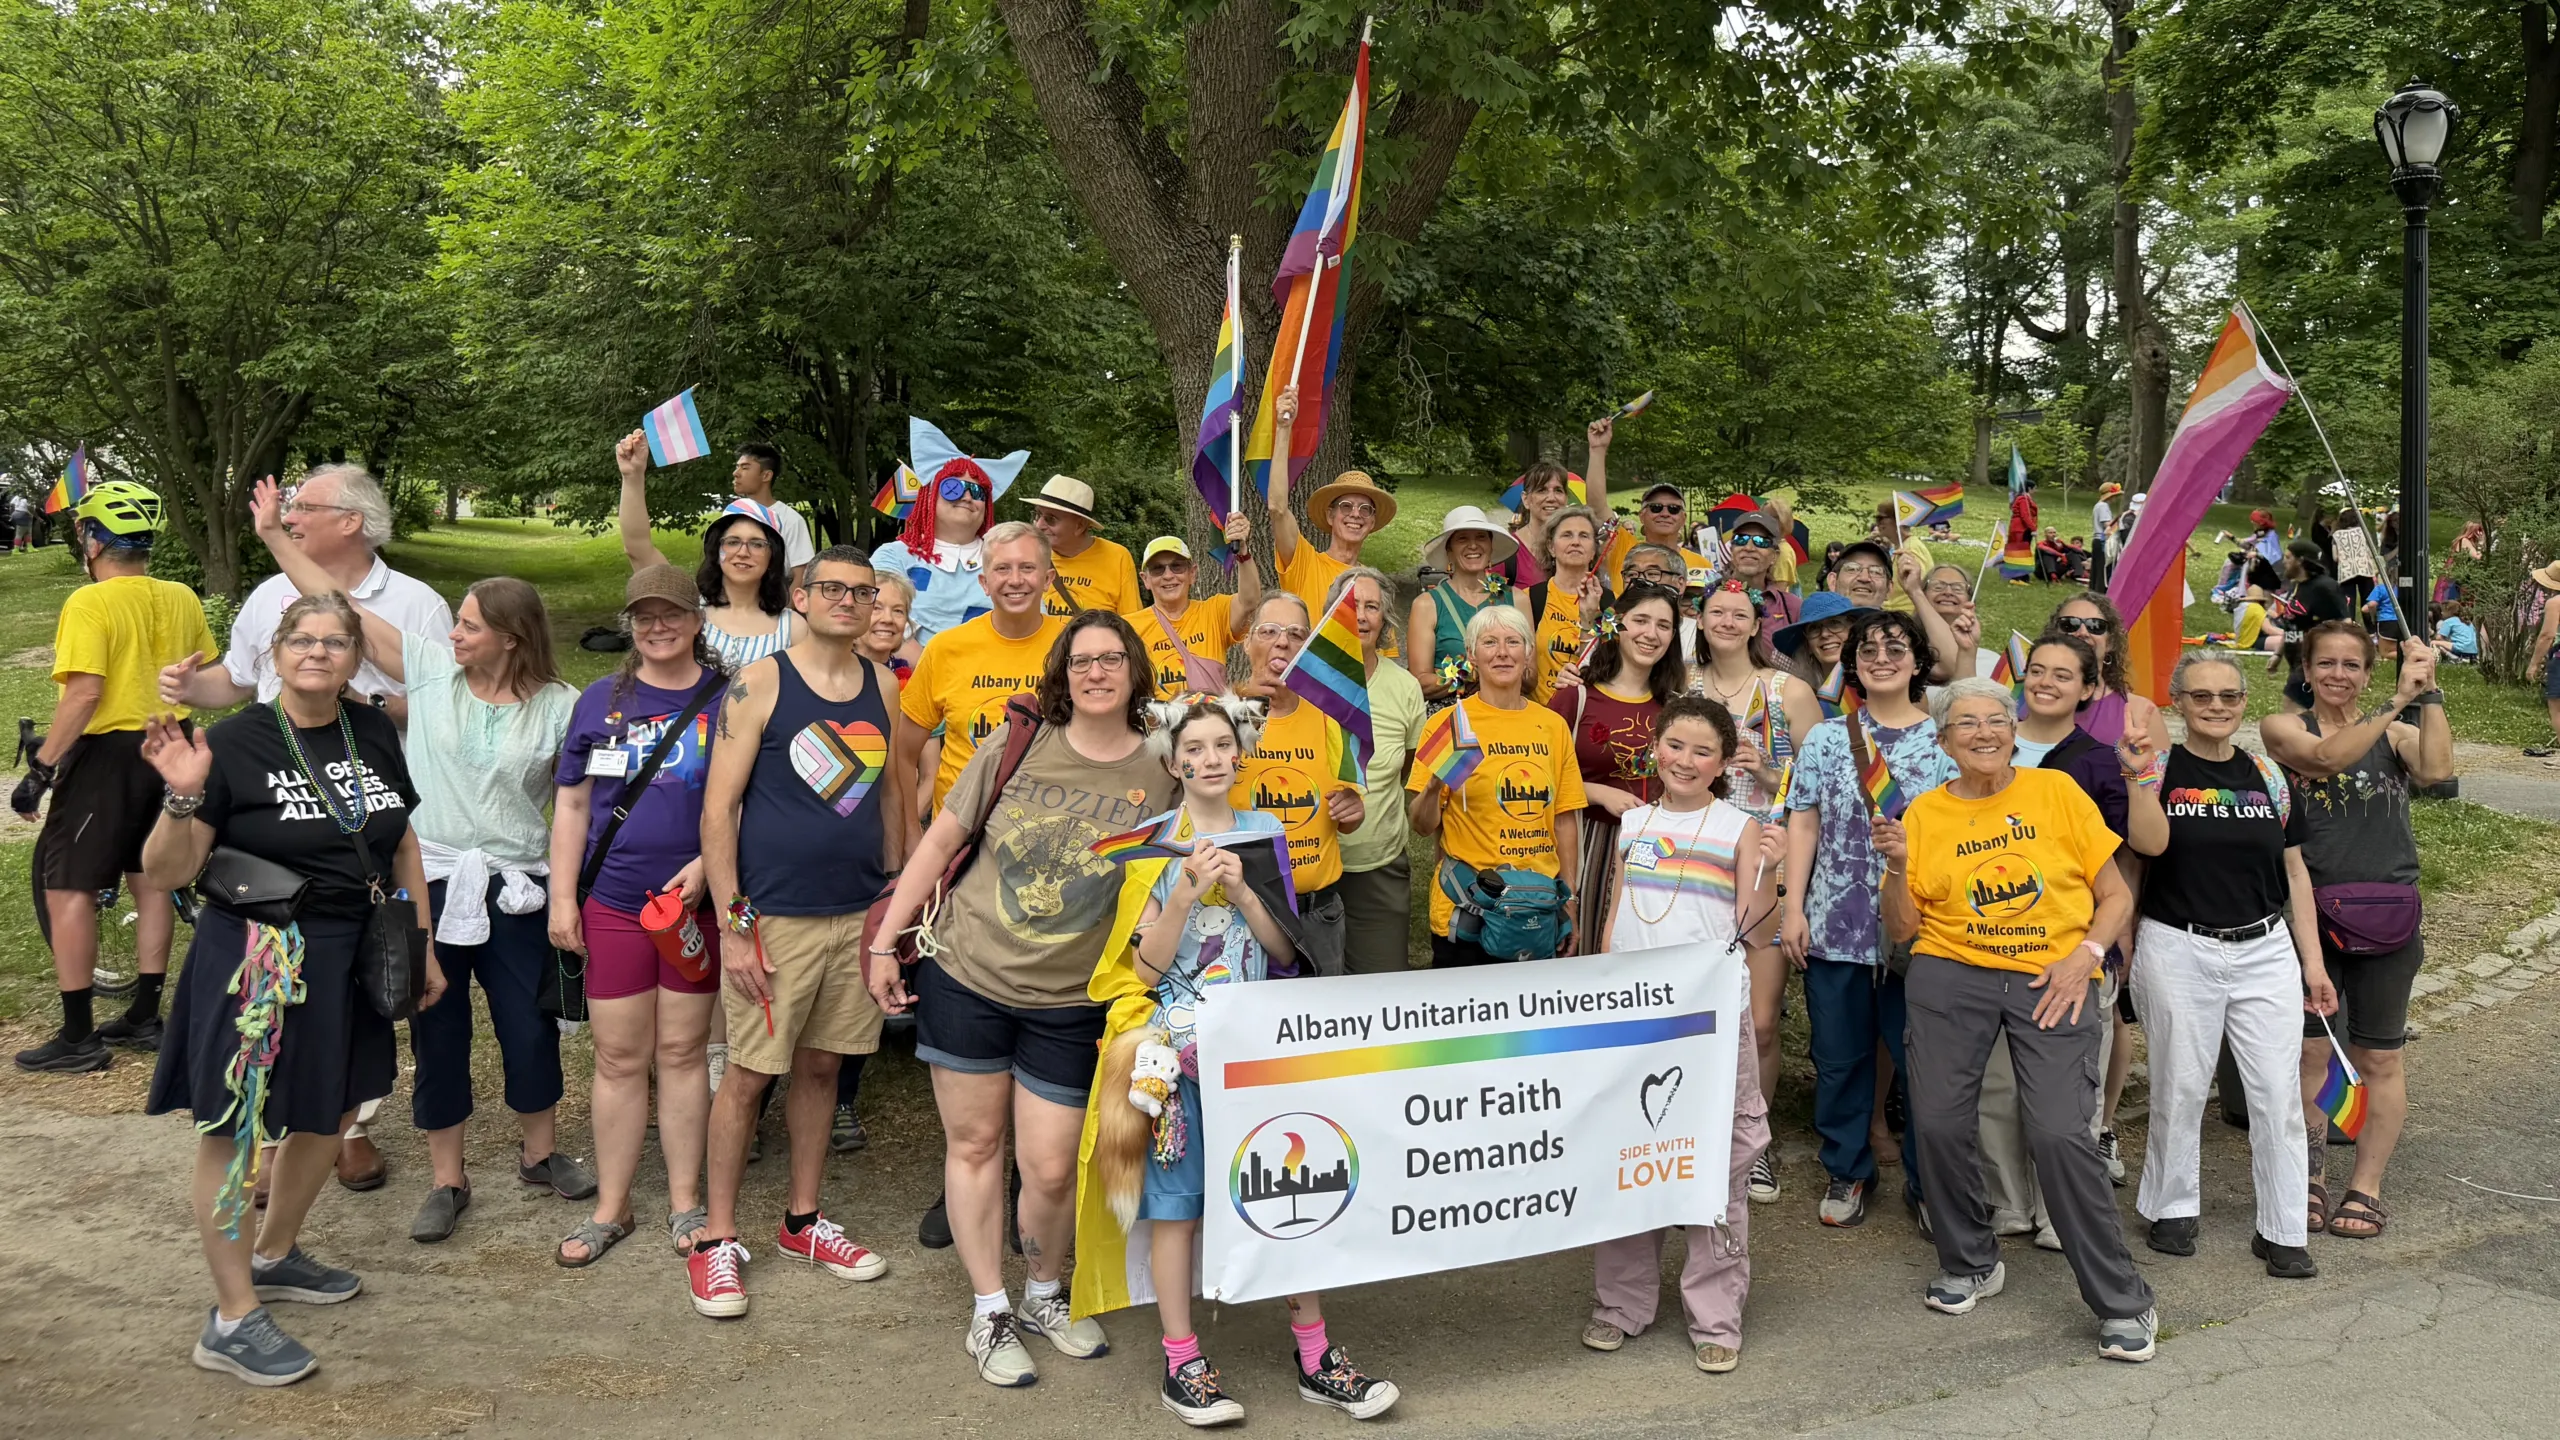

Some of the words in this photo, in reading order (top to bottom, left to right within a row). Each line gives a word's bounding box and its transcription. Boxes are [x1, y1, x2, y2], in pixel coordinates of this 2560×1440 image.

[1077, 575, 1092, 587] UU
[1153, 639, 1188, 652] Alby
[1190, 632, 1205, 645] UU
[971, 674, 1022, 692] Albany
[1025, 674, 1040, 689] U
[1294, 747, 1315, 760] UU
[1488, 742, 1530, 757] Albany
[1532, 742, 1549, 756] UU
[267, 769, 310, 788] ALL
[324, 759, 374, 781] GES.
[276, 787, 319, 804] ALL
[1005, 772, 1153, 829] HOZIER
[279, 803, 327, 821] ALL
[2166, 803, 2208, 817] LOVE
[2212, 804, 2230, 818] IS
[2234, 805, 2275, 819] LOVE
[1288, 836, 1320, 849] oming
[1500, 829, 1507, 839] A
[1508, 828, 1549, 840] Welcomin
[1956, 833, 2009, 857] Albany
[2011, 825, 2036, 841] UU
[1290, 853, 1321, 870] gation
[1966, 922, 1975, 935] A
[1976, 923, 2047, 938] Welcoming
[1276, 1013, 1373, 1045] Albany
[1382, 1000, 1509, 1032] Unitarian
[1519, 982, 1675, 1018] Universalist
[1404, 1094, 1469, 1126] Our
[1480, 1079, 1561, 1118] Faith
[1406, 1130, 1564, 1179] Demands
[1619, 1143, 1652, 1160] SIDE
[1656, 1137, 1695, 1154] WITH
[1618, 1155, 1695, 1191] LOVE
[1392, 1187, 1578, 1235] Democracy
